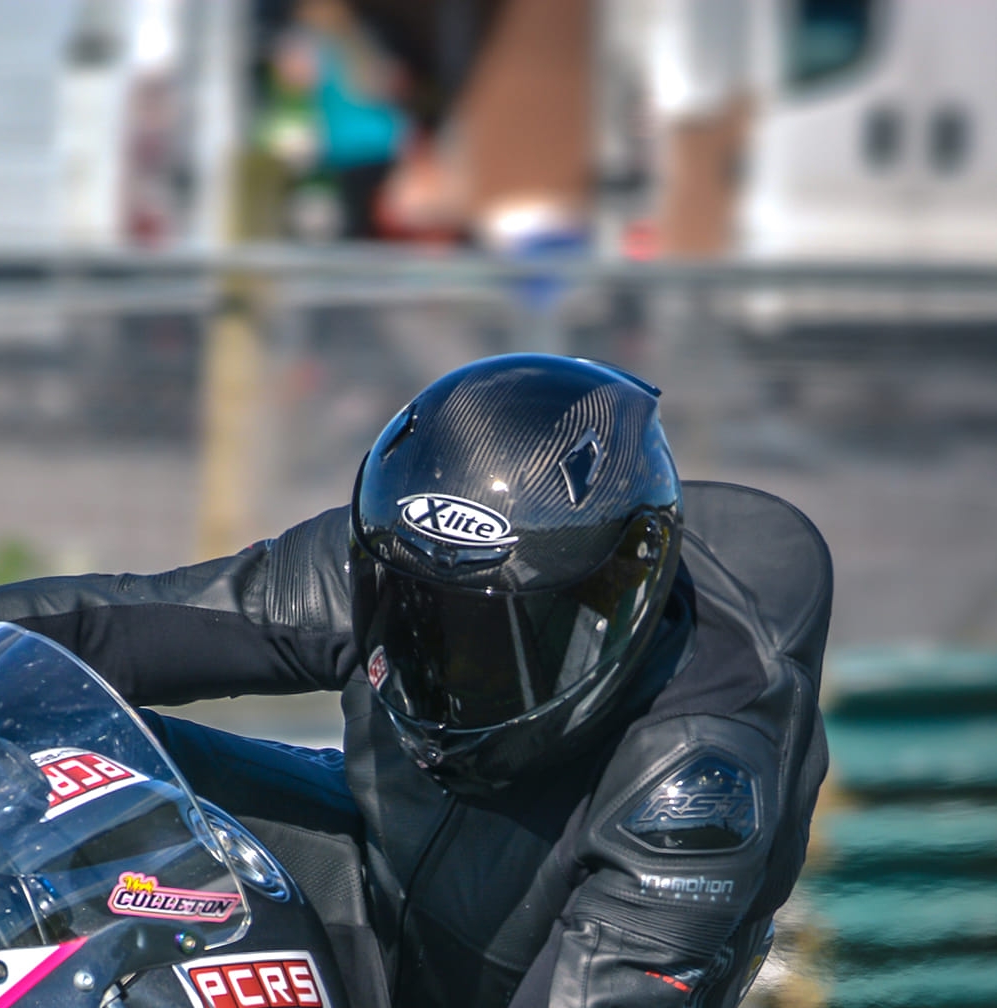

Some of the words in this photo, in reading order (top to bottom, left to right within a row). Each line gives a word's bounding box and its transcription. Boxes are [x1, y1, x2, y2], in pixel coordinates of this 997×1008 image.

[412, 497, 495, 539] X-lite
[46, 755, 127, 803] PCR
[116, 891, 230, 914] CULLETON
